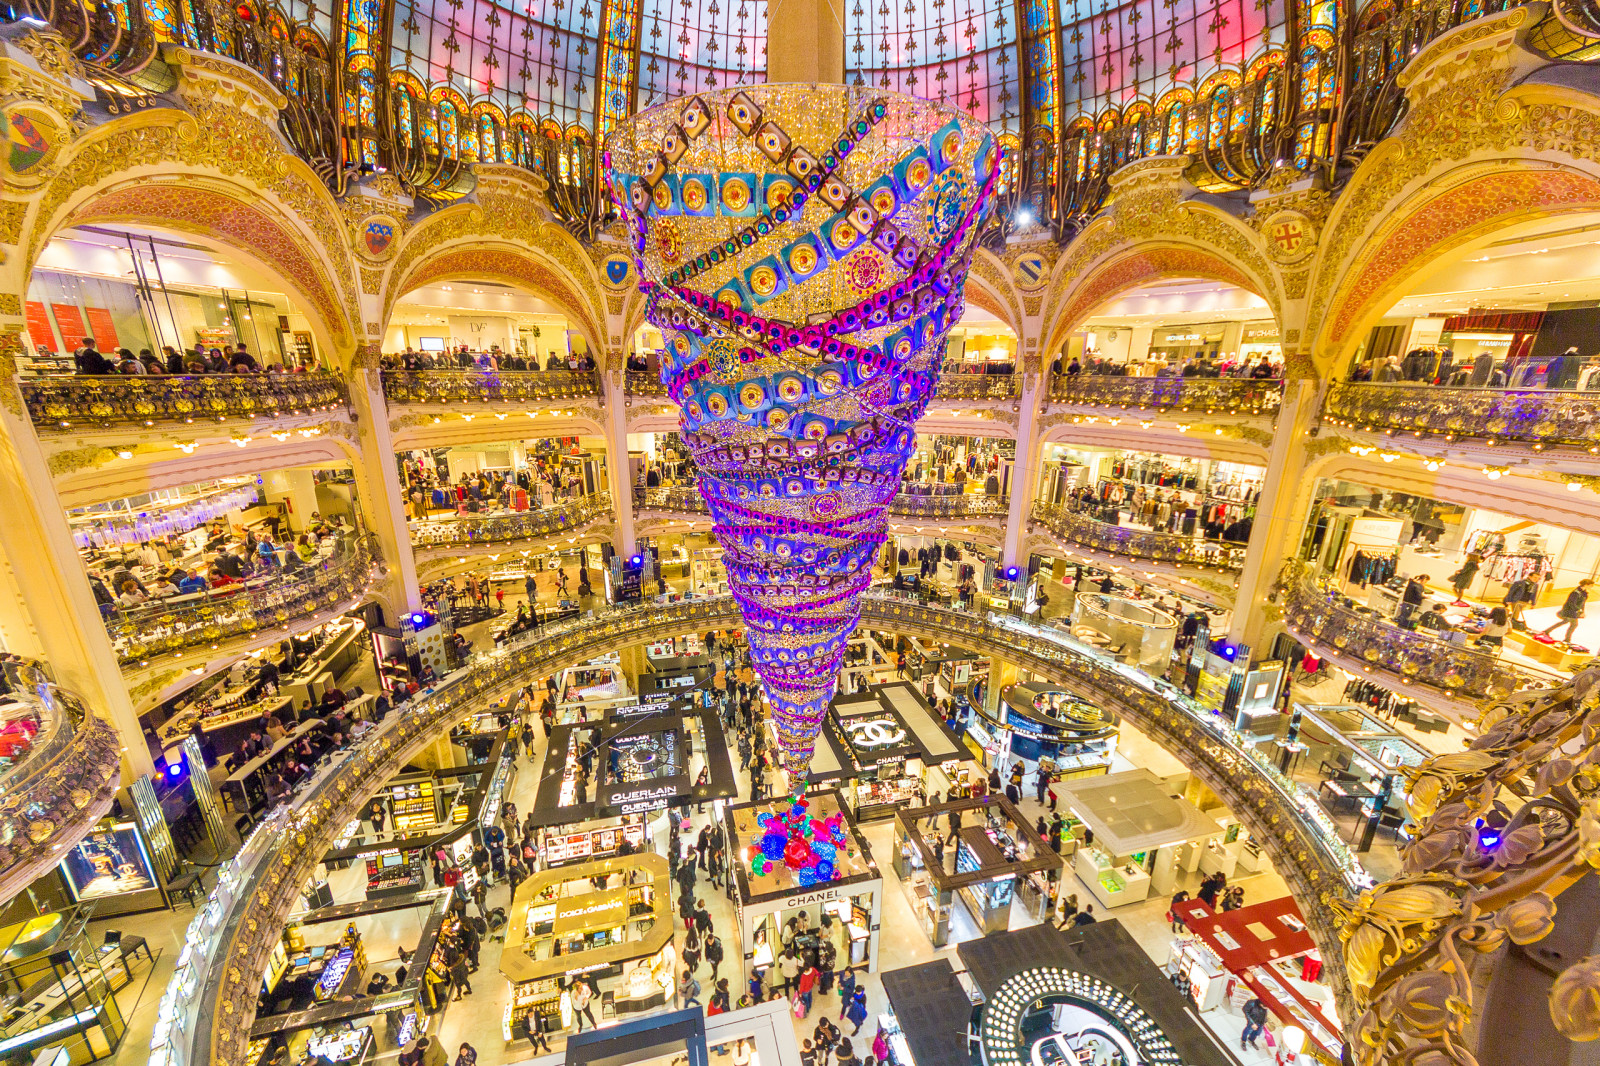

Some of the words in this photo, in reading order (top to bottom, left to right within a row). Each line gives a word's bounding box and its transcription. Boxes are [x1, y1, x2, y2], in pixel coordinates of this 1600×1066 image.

[470, 322, 487, 332] DVF
[876, 755, 906, 765] CHANEL
[611, 786, 677, 801] GUERLAIN
[622, 799, 668, 812] GUERLAIN
[788, 889, 842, 907] CHANEL
